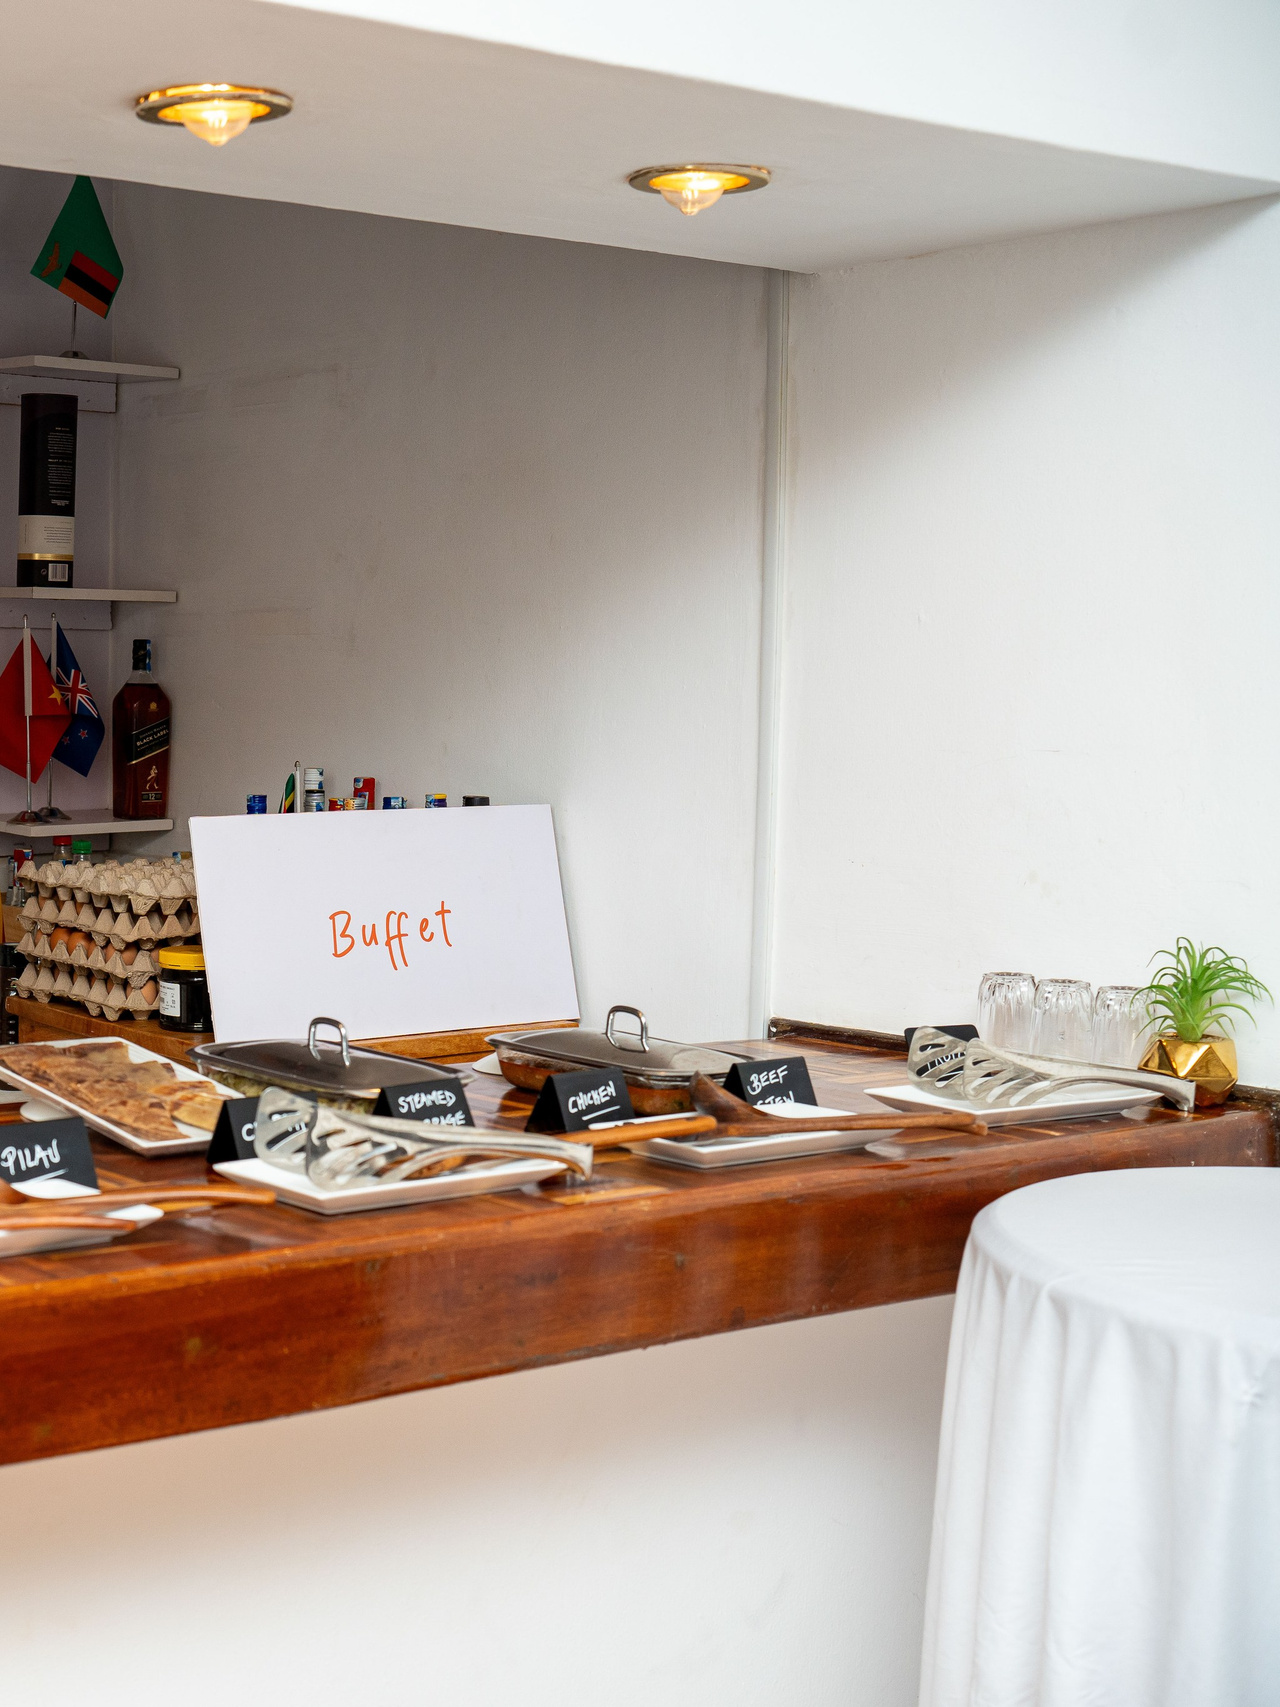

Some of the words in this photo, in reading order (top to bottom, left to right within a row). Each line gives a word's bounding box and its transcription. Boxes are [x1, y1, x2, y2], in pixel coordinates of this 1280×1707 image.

[328, 900, 453, 971] Buffet
[567, 1080, 617, 1114] CHICKEN
[746, 1064, 789, 1096] BEEF
[397, 1089, 457, 1114] STEAMED
[0, 1138, 61, 1176] PILAU
